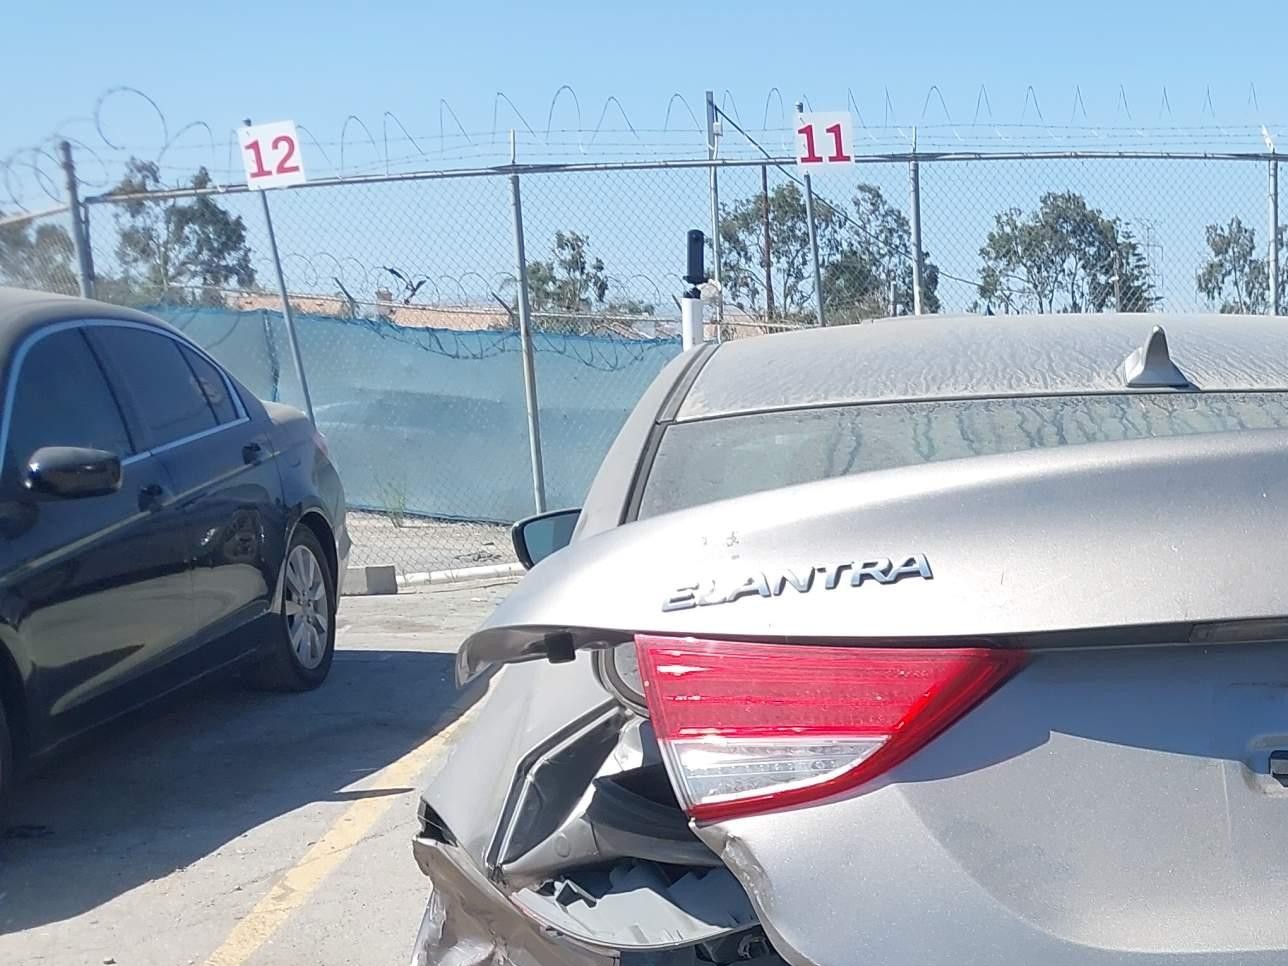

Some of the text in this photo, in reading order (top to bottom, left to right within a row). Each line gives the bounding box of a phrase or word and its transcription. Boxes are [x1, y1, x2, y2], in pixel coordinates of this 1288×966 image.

[244, 135, 300, 178] 12
[797, 123, 851, 163] 11
[661, 552, 934, 612] ELANTRA
